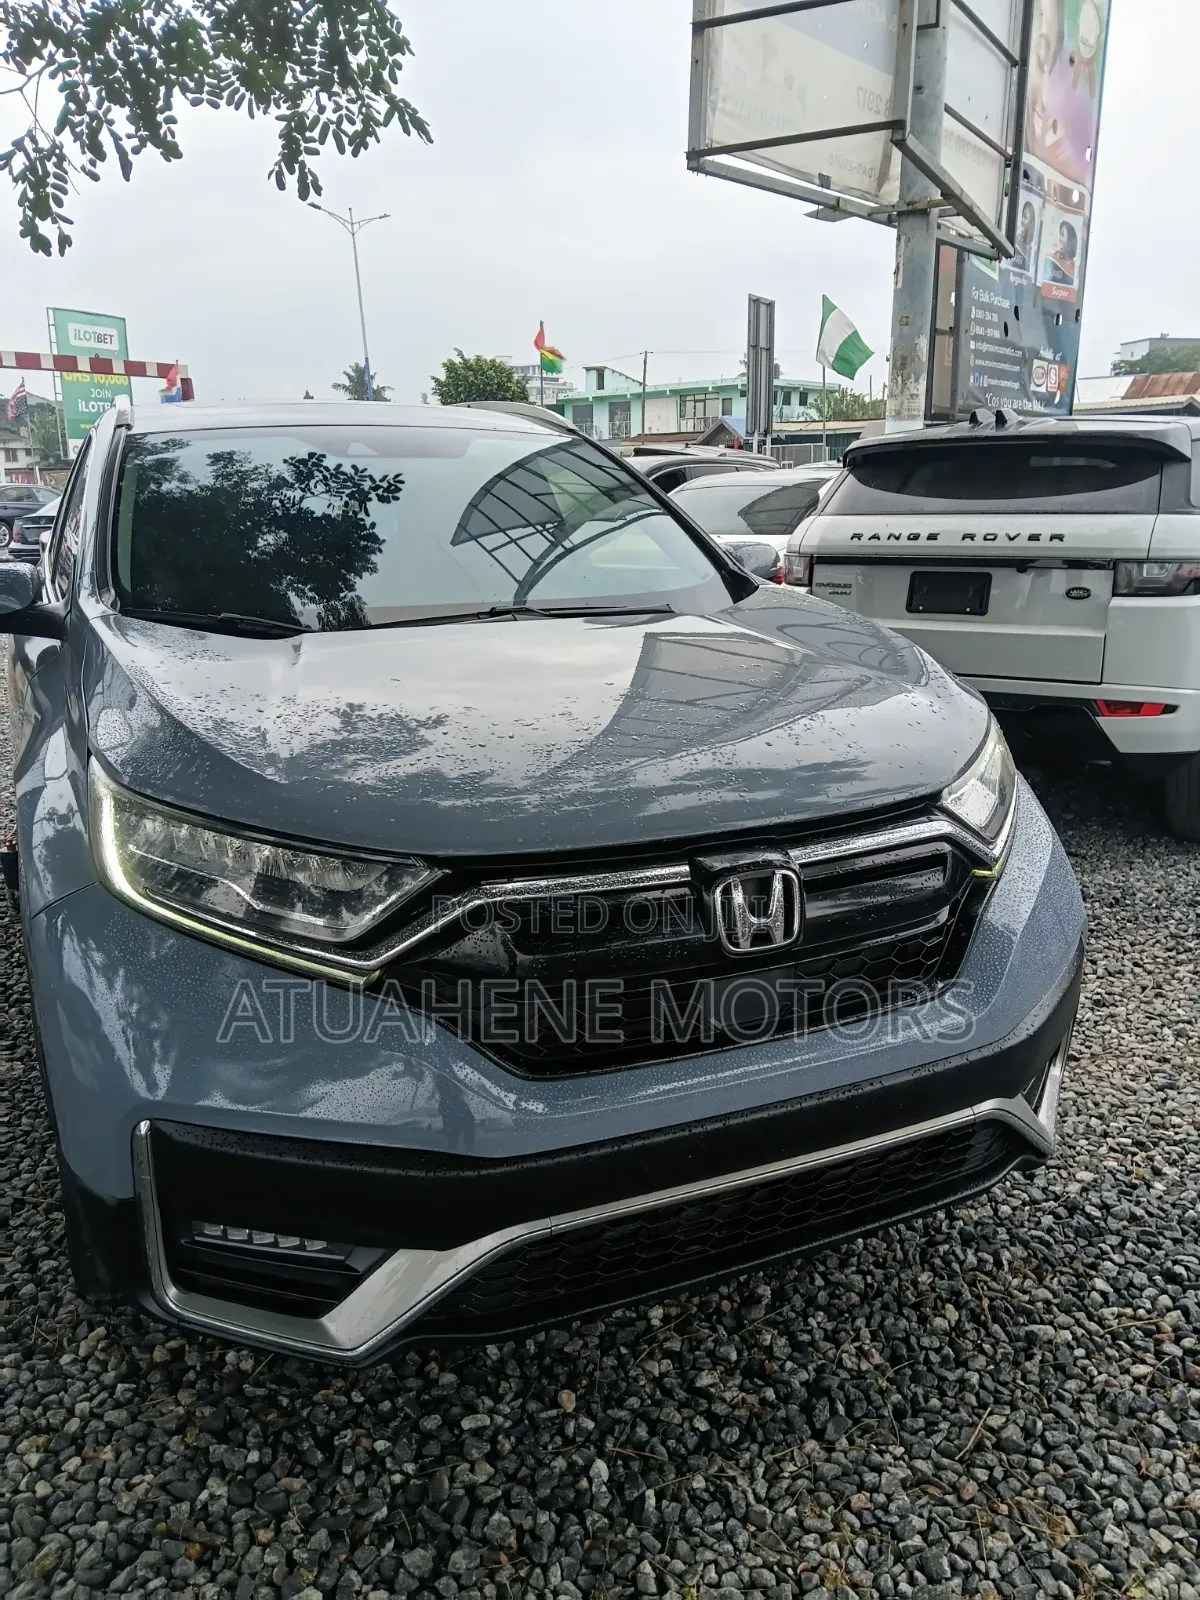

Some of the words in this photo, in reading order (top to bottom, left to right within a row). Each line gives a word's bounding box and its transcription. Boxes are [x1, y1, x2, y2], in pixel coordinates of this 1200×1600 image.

[1052, 286, 1069, 297] Super
[979, 288, 990, 303] Bulk
[990, 292, 1010, 309] Purchase
[73, 329, 114, 345] iLOTBET
[90, 388, 112, 398] JOIN
[1012, 399, 1022, 410] are
[1022, 398, 1032, 411] the
[850, 532, 940, 541] RANGE
[961, 532, 1065, 542] ROVER
